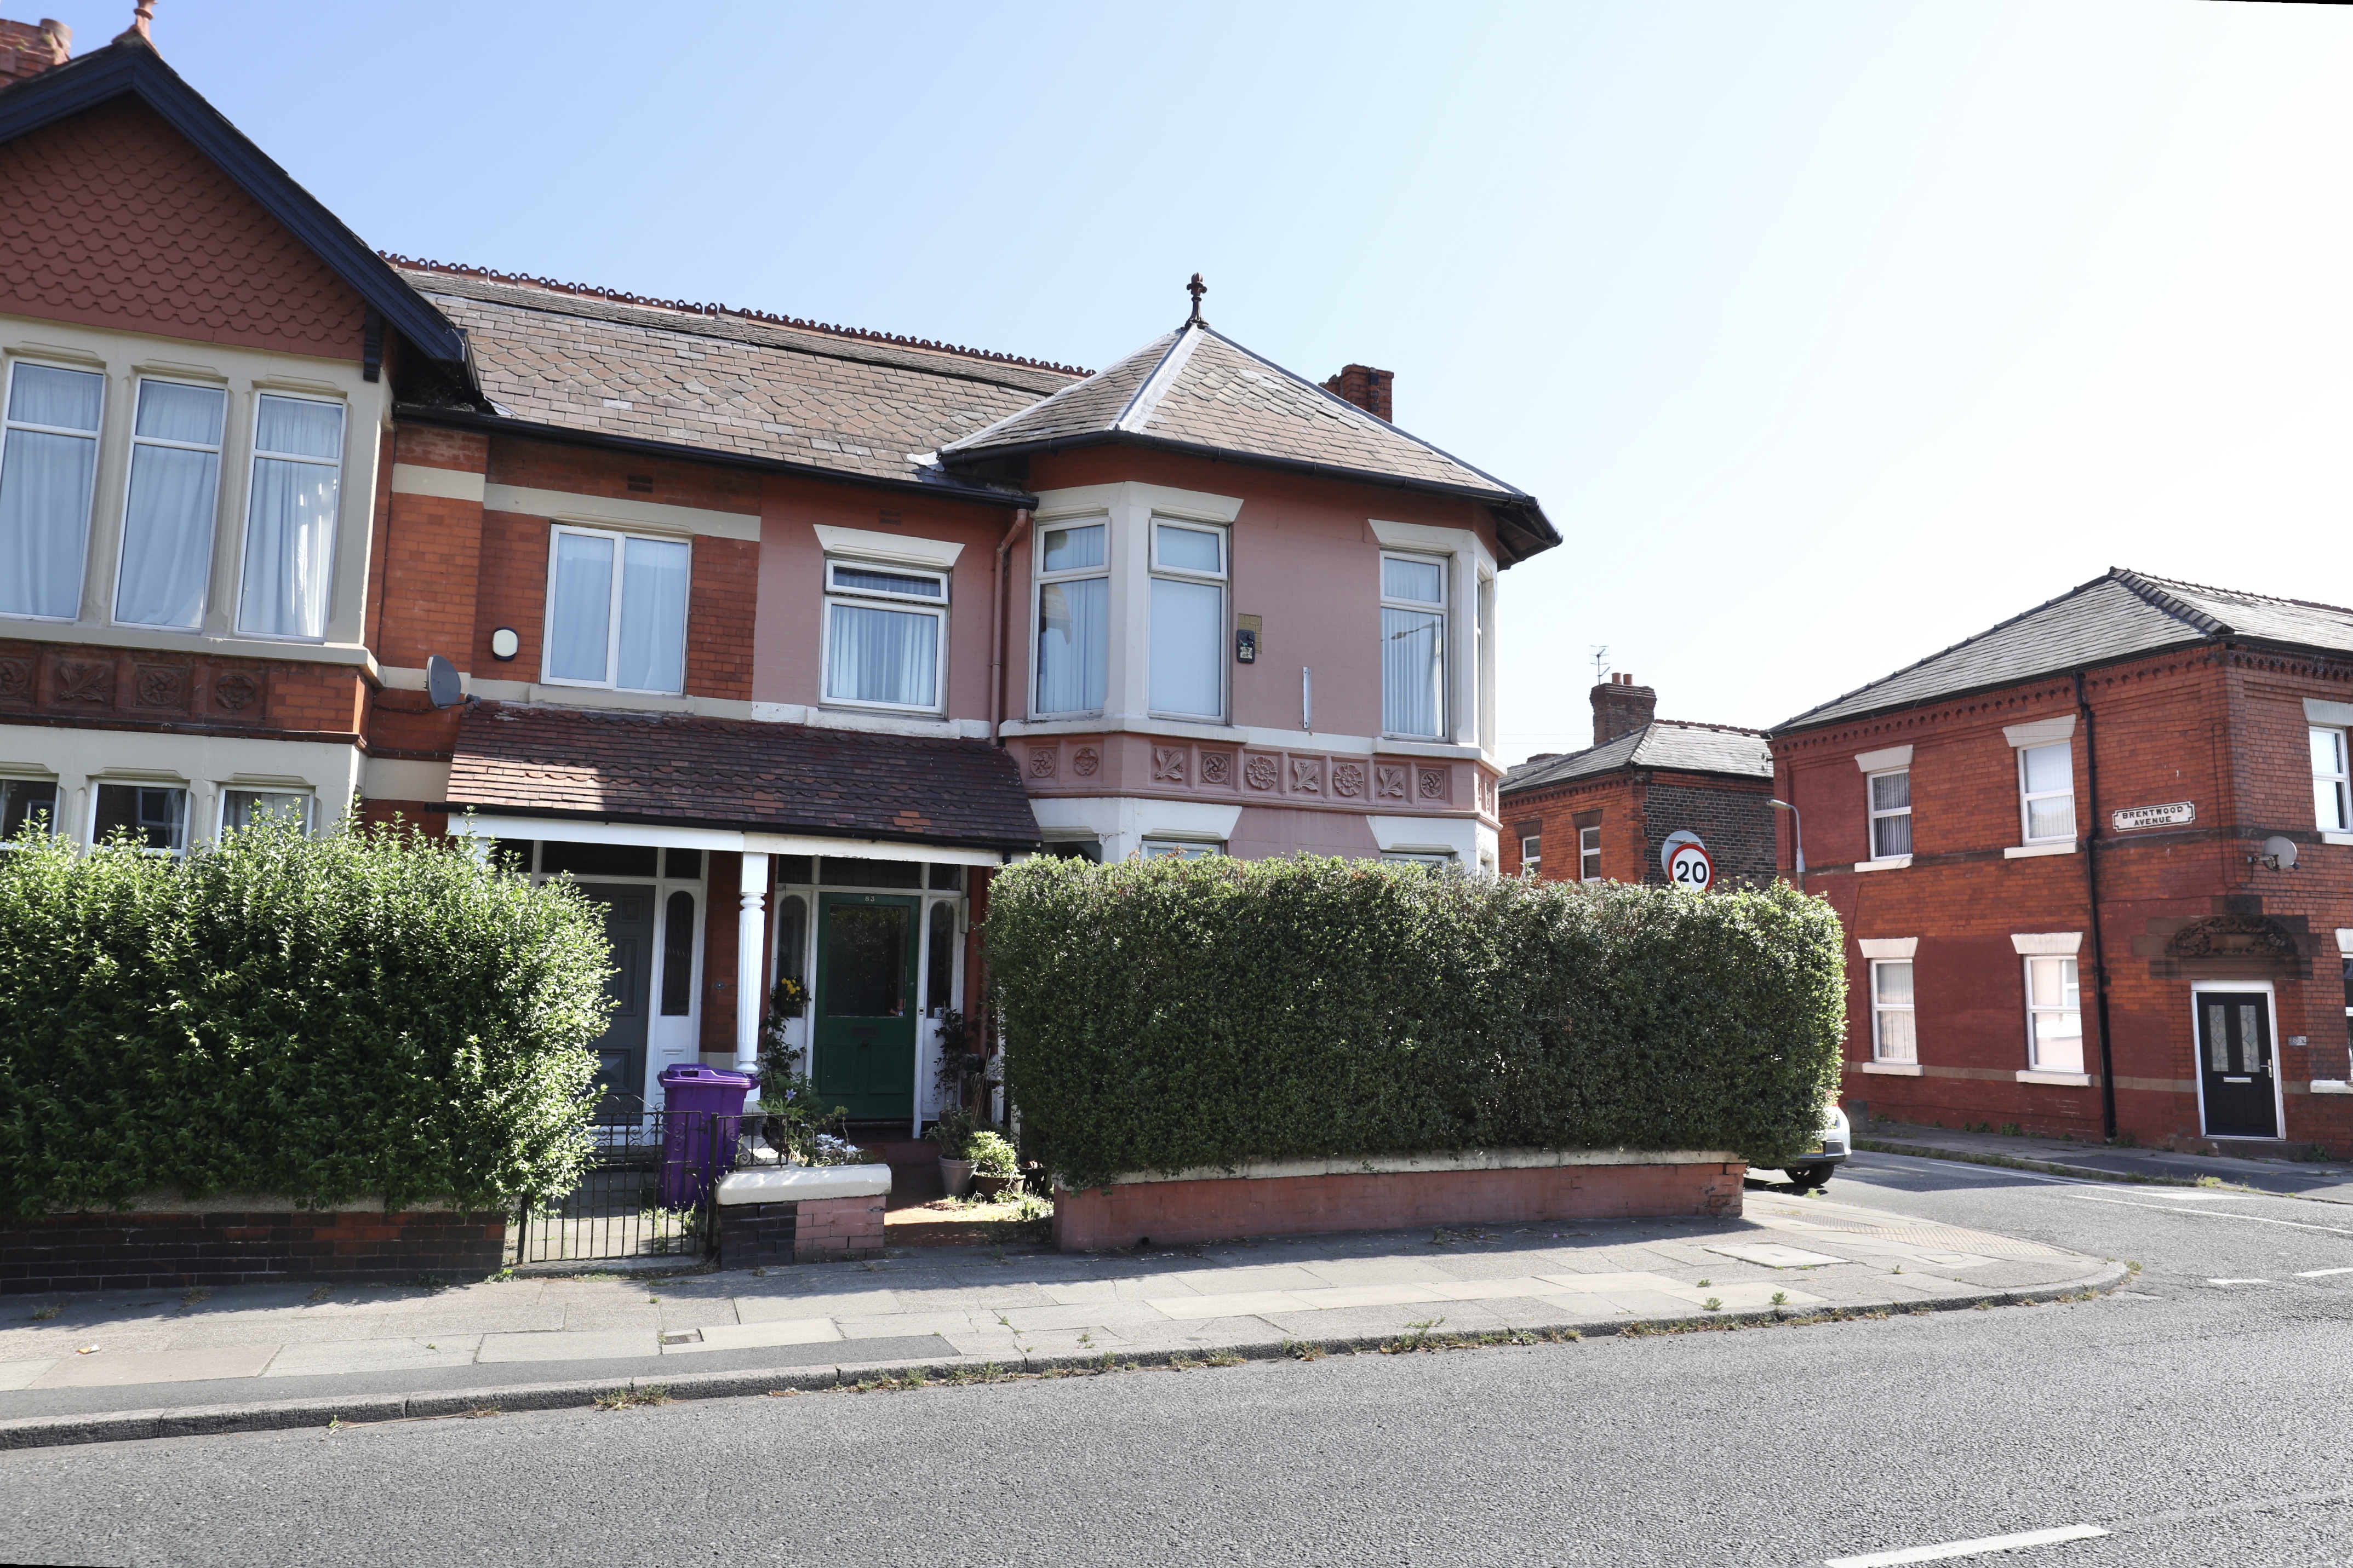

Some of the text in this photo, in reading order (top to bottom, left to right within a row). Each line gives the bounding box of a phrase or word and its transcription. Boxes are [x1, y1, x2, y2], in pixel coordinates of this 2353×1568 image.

[2122, 806, 2183, 819] BRENTWOOD
[2134, 816, 2172, 826] AVENUE
[1676, 860, 1707, 883] 20
